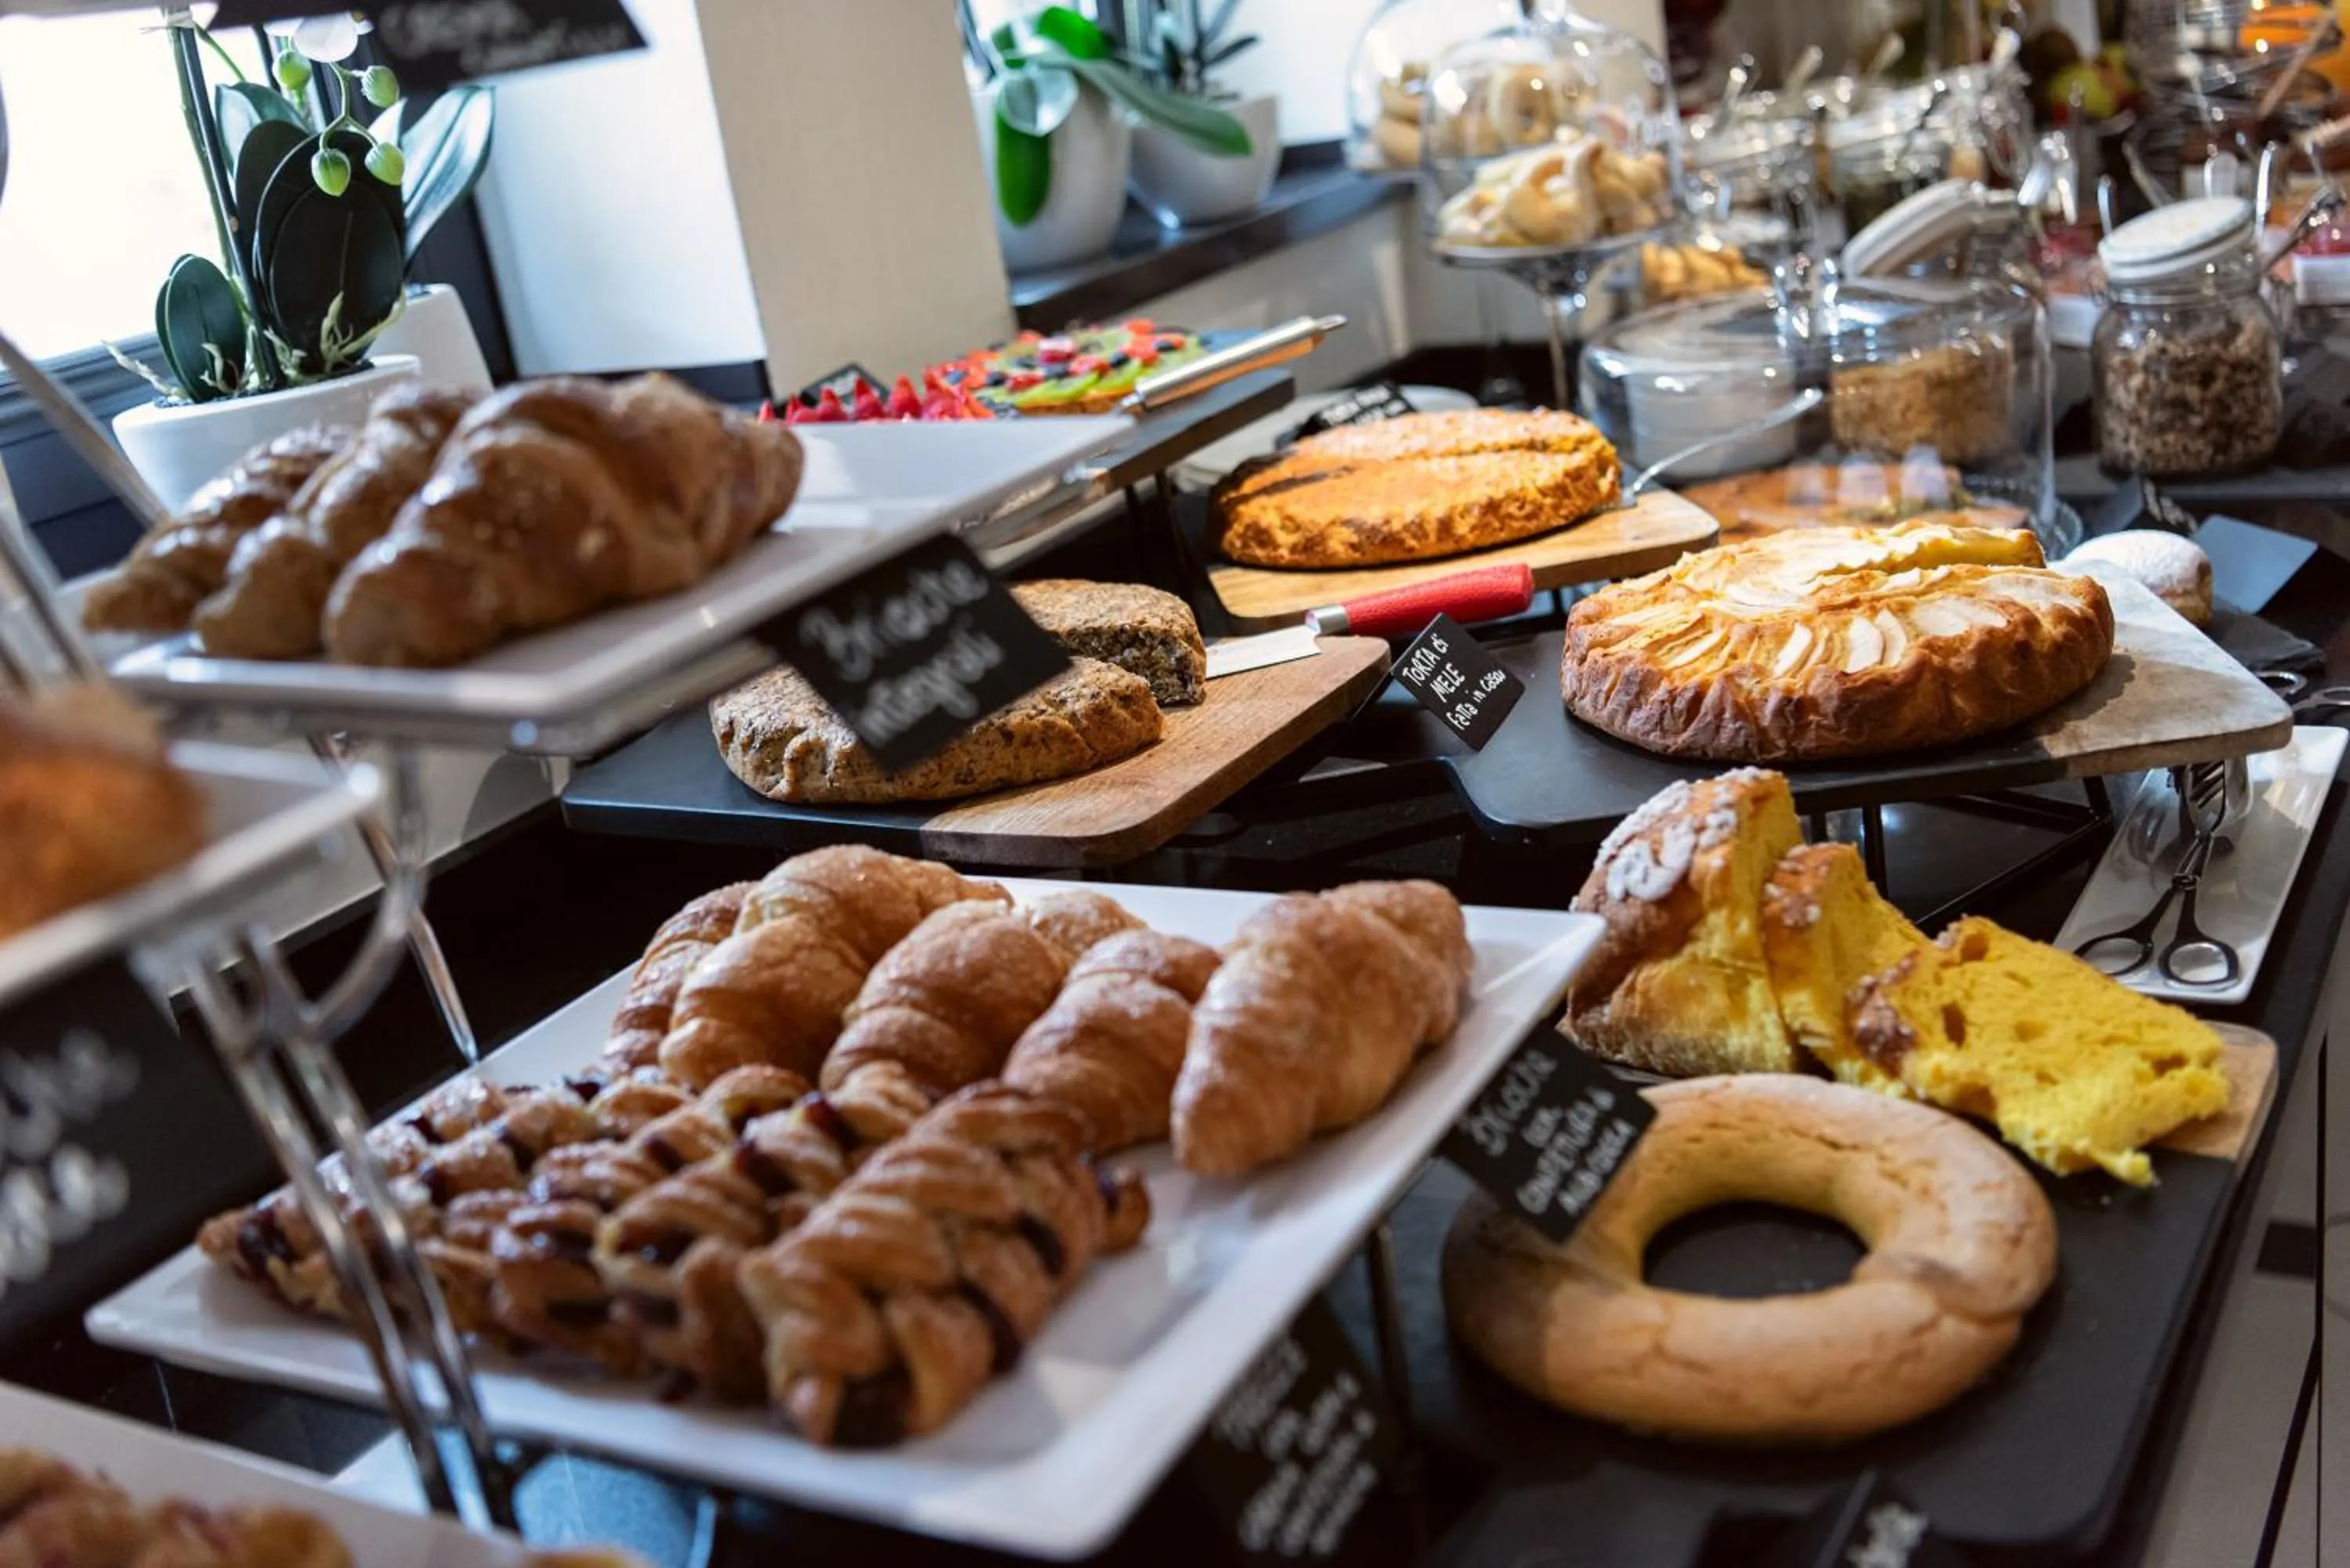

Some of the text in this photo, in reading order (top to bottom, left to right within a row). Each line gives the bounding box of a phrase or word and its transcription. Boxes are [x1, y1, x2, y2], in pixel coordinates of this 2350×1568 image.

[1402, 647, 1441, 687] TORTA
[1430, 663, 1466, 703] MELE
[1466, 690, 1486, 703] in
